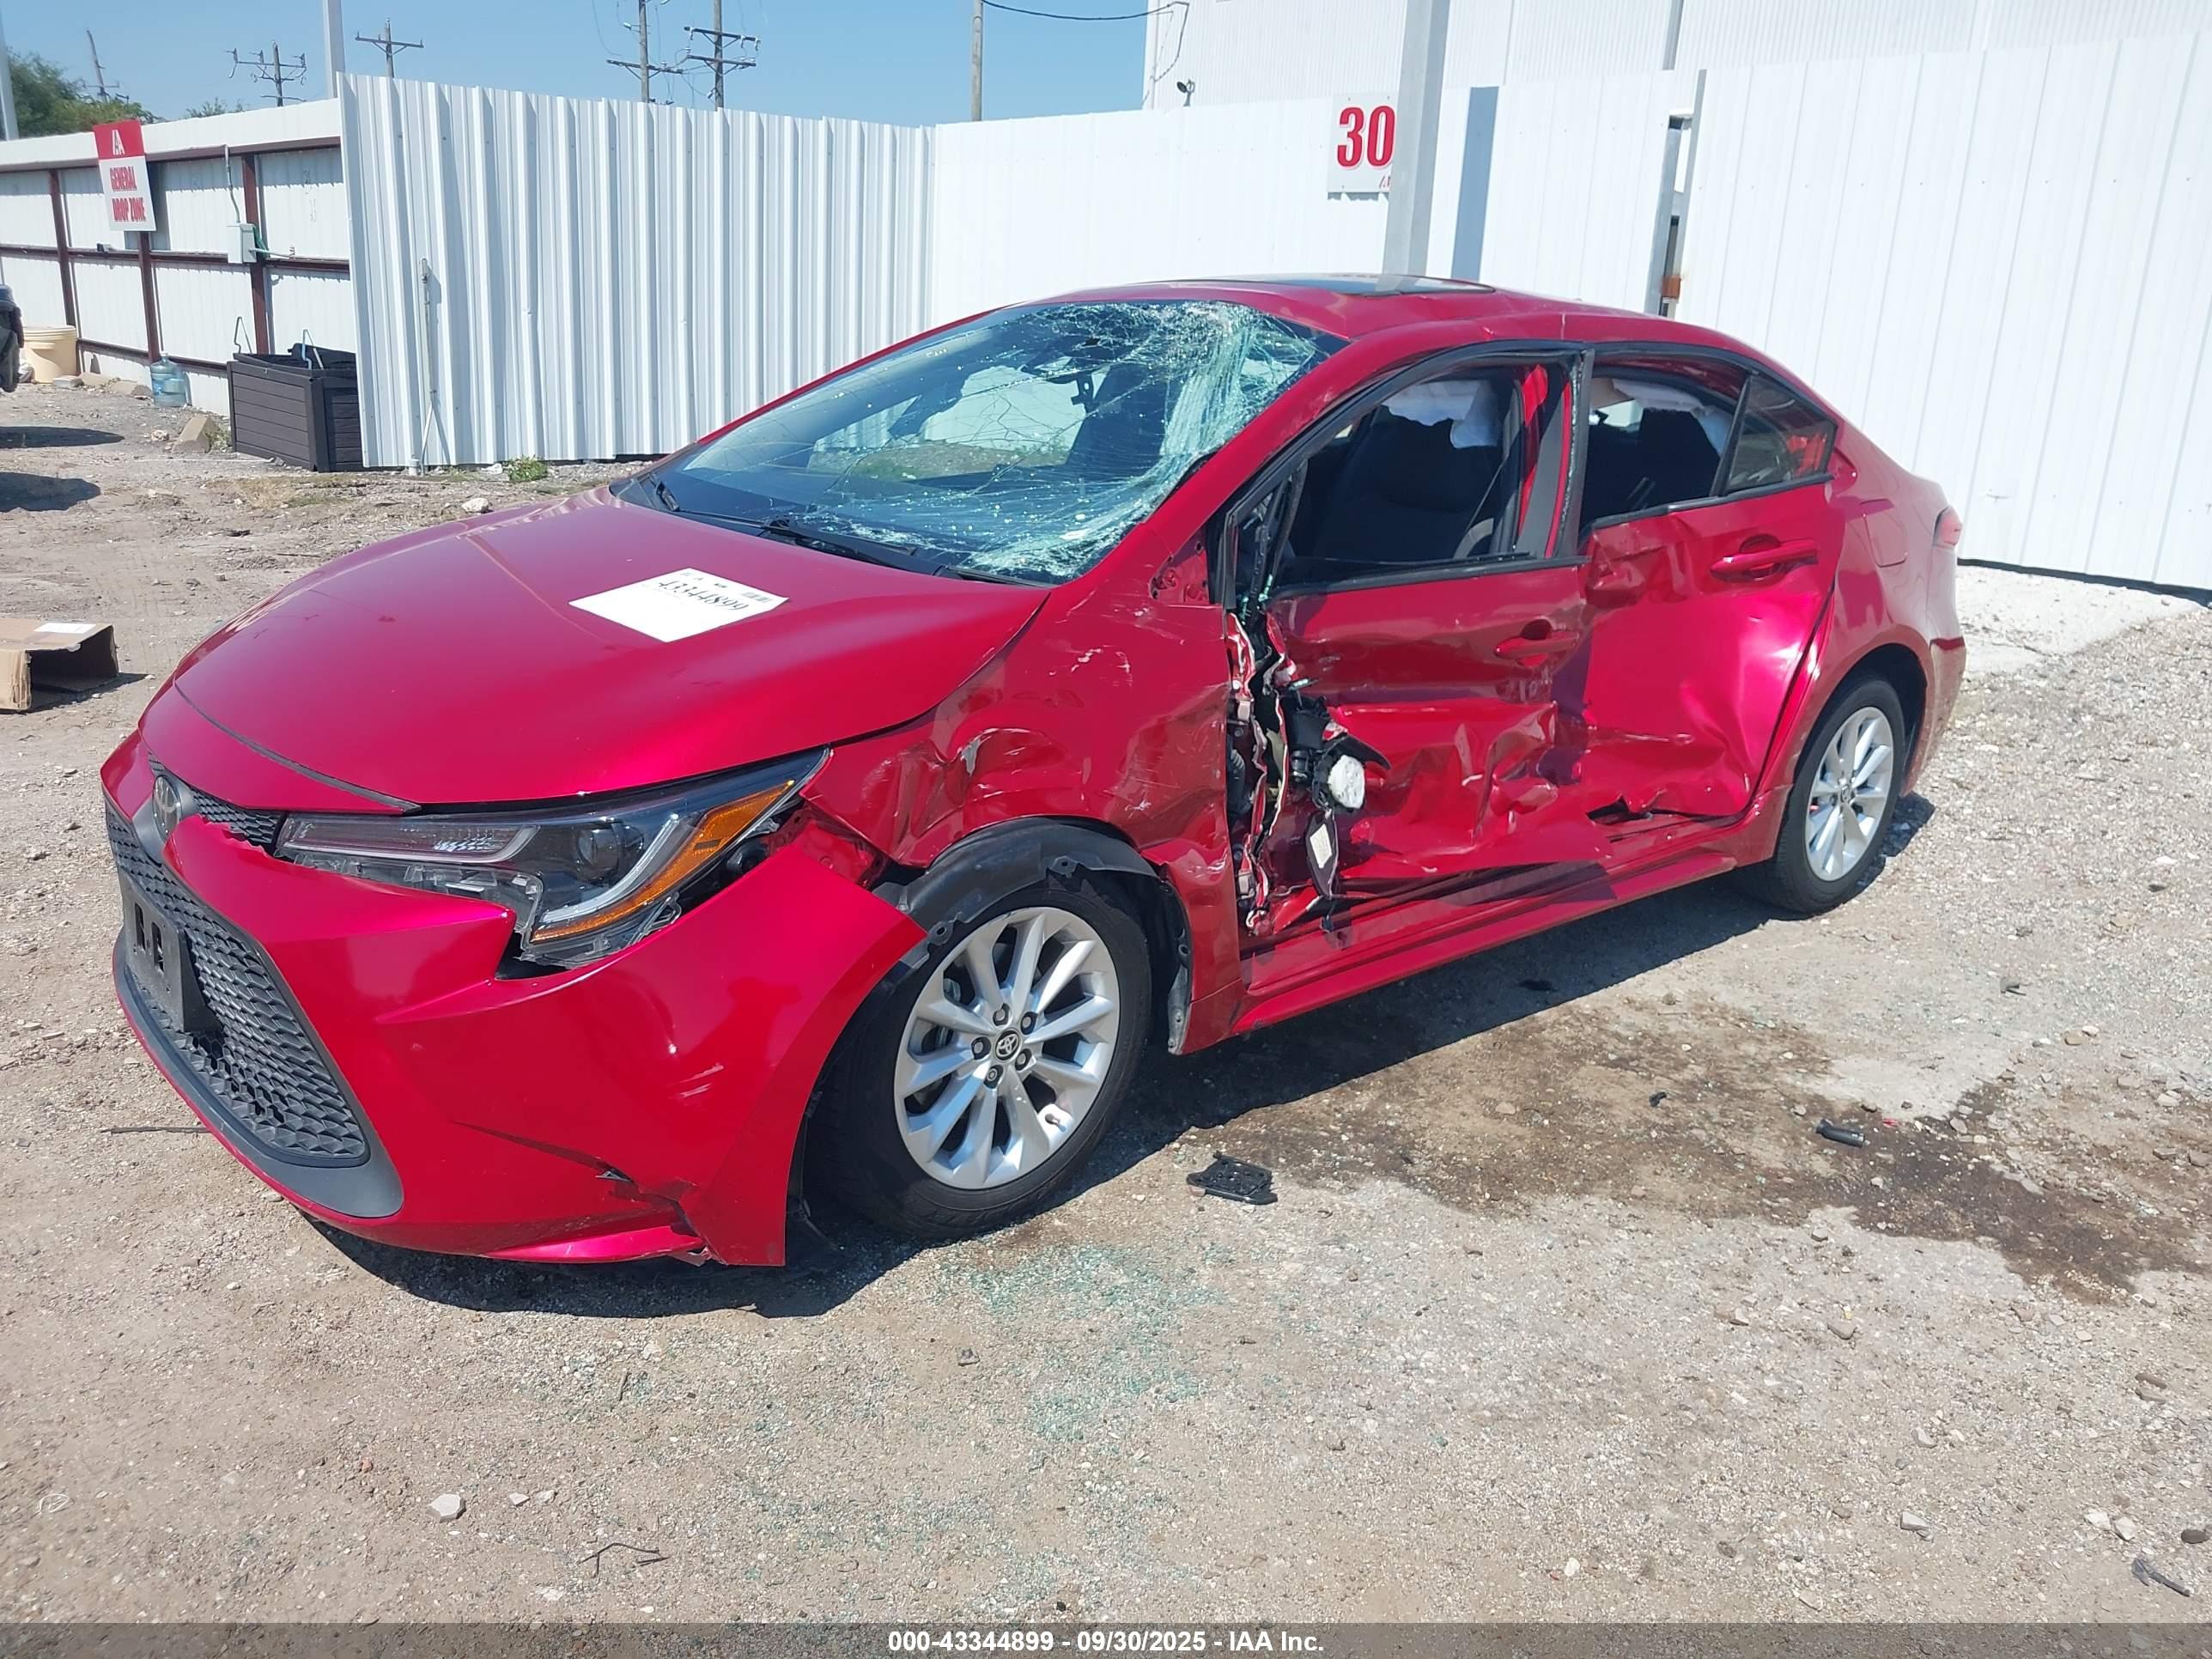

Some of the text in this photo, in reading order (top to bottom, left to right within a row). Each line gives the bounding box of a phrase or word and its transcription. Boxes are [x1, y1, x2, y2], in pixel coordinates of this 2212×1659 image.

[1337, 106, 1395, 167] 30
[109, 166, 137, 191] GENERAL
[112, 197, 147, 222] DROP ZONE
